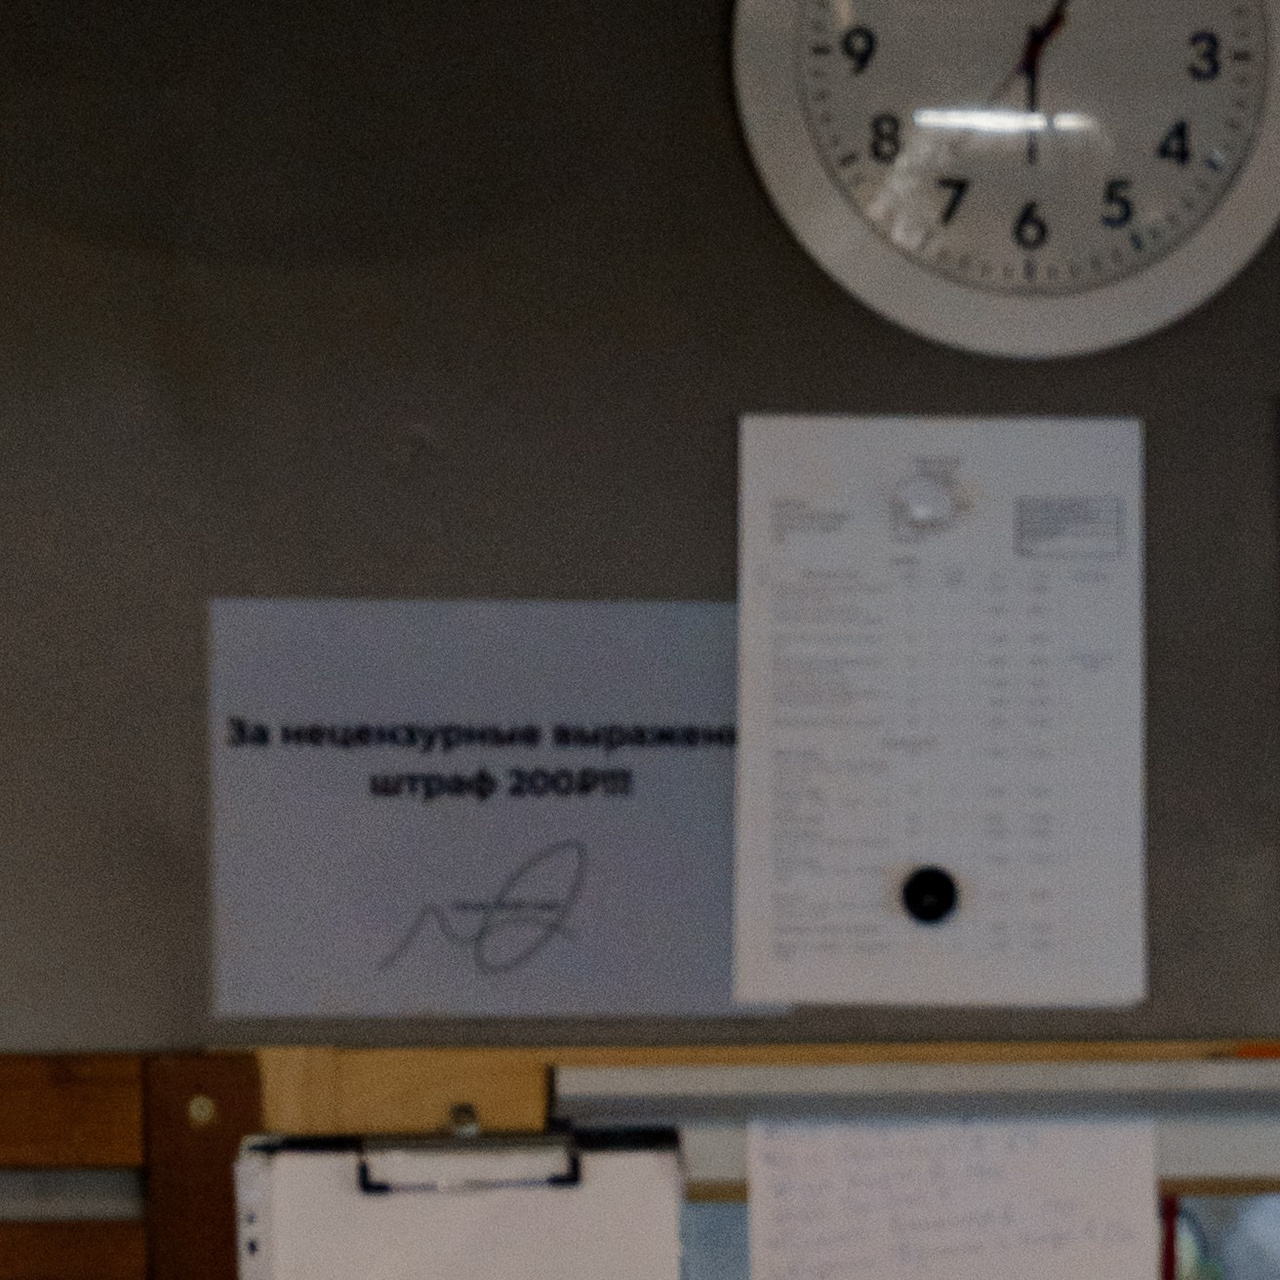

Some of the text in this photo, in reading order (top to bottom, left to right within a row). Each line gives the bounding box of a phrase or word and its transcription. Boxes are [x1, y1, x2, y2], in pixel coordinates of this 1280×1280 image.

[843, 26, 877, 73] 9
[1187, 31, 1221, 81] 3
[870, 114, 900, 164] 8
[1158, 121, 1190, 166] 4
[935, 178, 970, 225] 7
[1101, 180, 1133, 228] 5
[1014, 203, 1047, 249] 6
[229, 717, 270, 747] За
[281, 724, 542, 753] нецензурные
[369, 767, 498, 802] штраф
